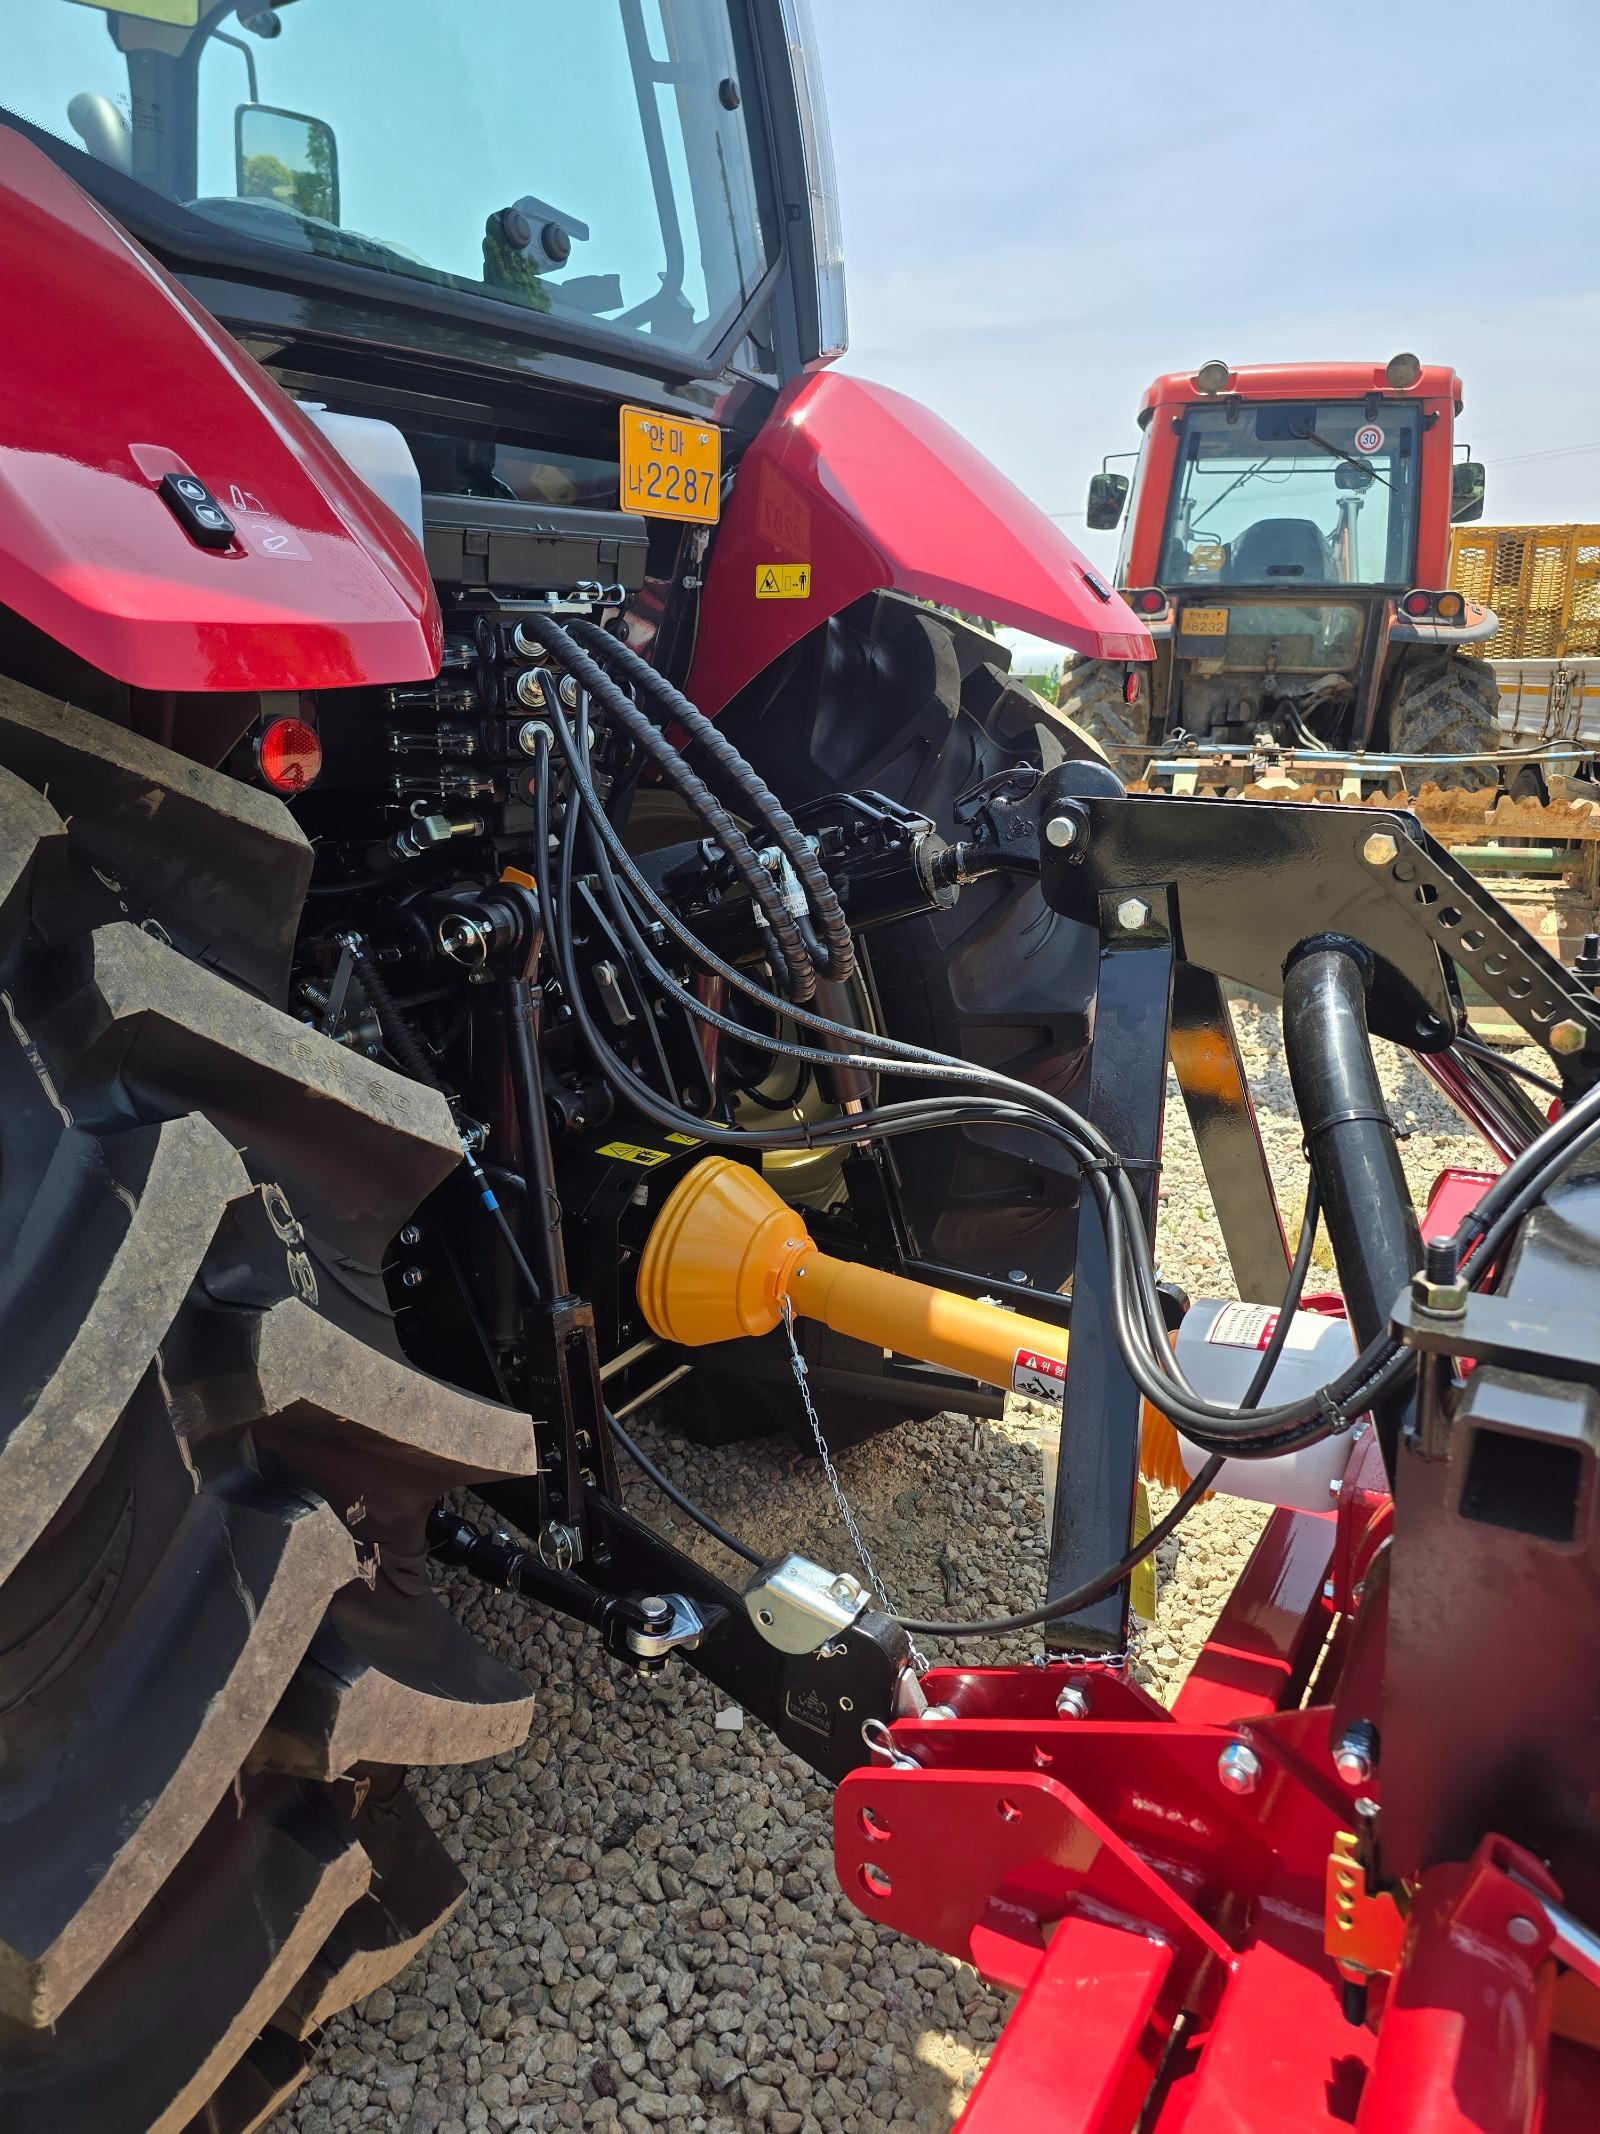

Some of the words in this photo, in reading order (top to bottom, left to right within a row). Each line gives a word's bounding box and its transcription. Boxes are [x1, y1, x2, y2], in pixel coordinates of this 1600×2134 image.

[1362, 433, 1377, 445] 30
[629, 462, 714, 505] 나2287
[758, 990, 780, 1006] EN853
[662, 980, 688, 1005] EUROTEC
[688, 1003, 724, 1028] HYDRAULIC
[725, 1024, 744, 1038] HOSE
[745, 1033, 760, 1044] SAE
[820, 1055, 834, 1063] 1SN
[843, 1029, 857, 1040] SAE
[863, 1035, 882, 1047] HOSE
